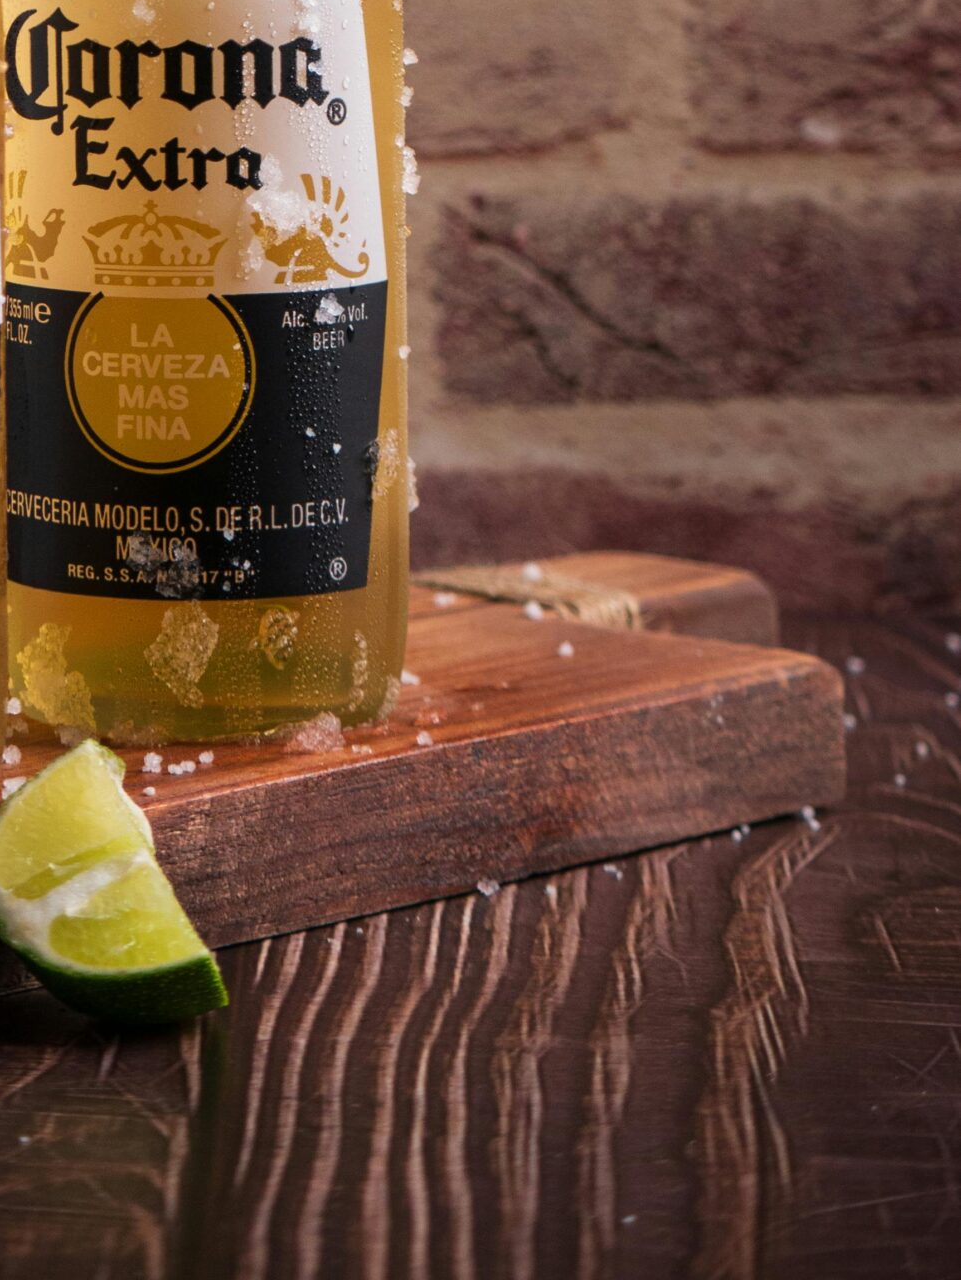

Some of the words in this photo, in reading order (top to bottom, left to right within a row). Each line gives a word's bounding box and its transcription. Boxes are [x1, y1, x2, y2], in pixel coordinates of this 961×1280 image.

[5, 7, 329, 136] Corona
[70, 114, 265, 192] Extra
[281, 310, 309, 329] Alc.
[347, 302, 369, 322] Vol.
[130, 322, 175, 348] LA
[313, 329, 345, 351] BEER
[82, 350, 231, 380] CERVEZA
[118, 383, 189, 411] MAS
[117, 414, 191, 441] FINA
[94, 503, 186, 535] MODELO,
[216, 506, 242, 531] DE
[292, 502, 316, 527] DE
[68, 563, 100, 580] REG.
